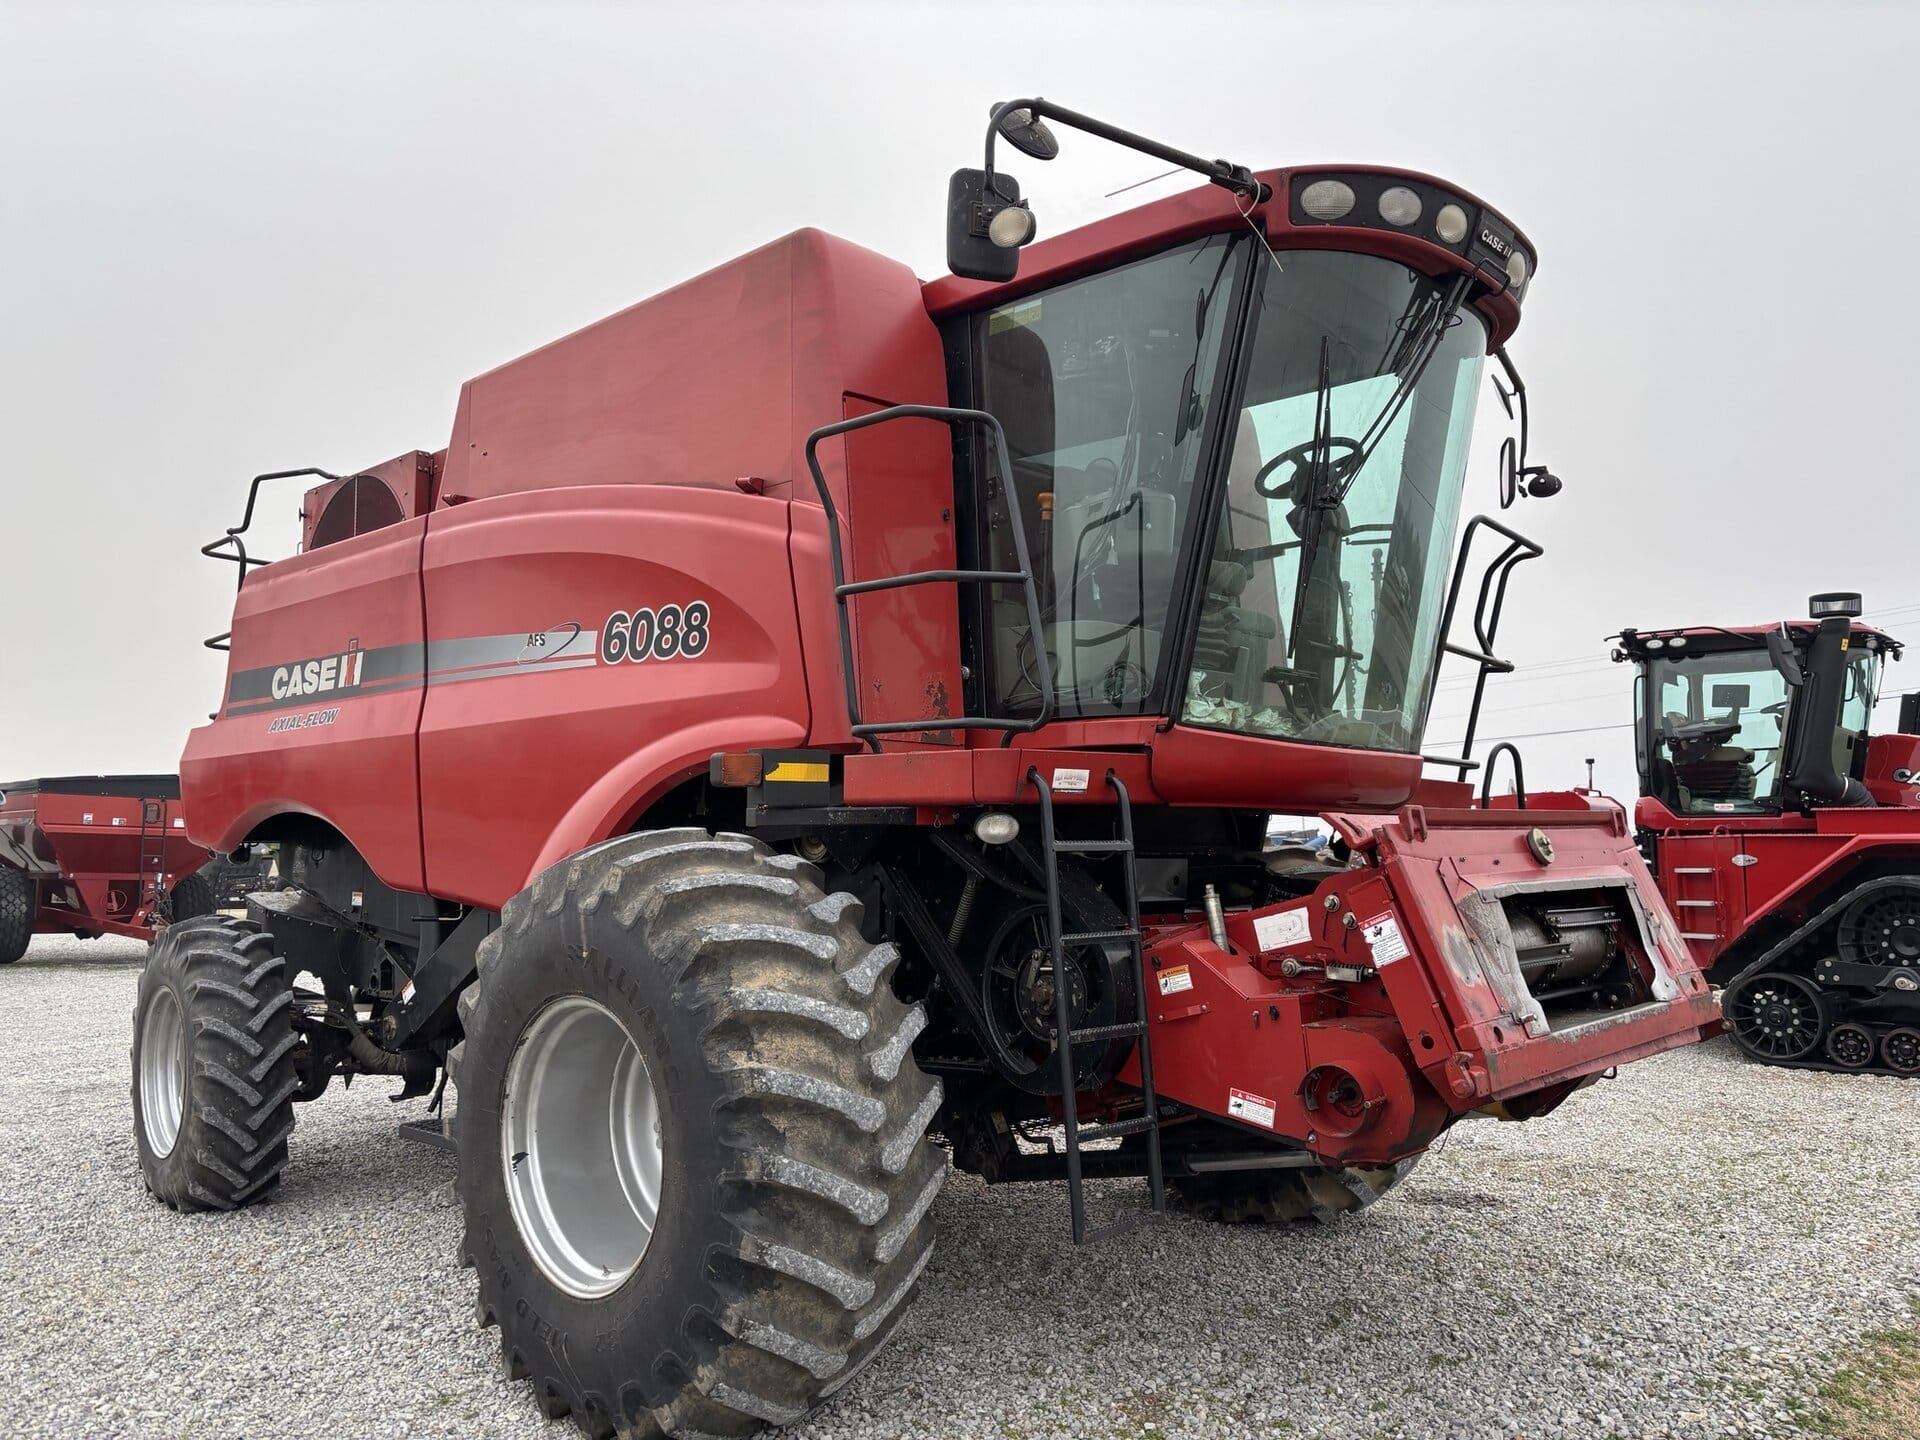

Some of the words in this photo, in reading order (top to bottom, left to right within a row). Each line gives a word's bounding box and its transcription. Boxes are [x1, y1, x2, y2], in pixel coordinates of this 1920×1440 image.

[1481, 229, 1505, 252] CASE
[527, 633, 546, 647] AFS
[602, 600, 711, 665] 6088
[271, 657, 337, 700] CASE
[267, 707, 341, 734] AXIAL-FLOW
